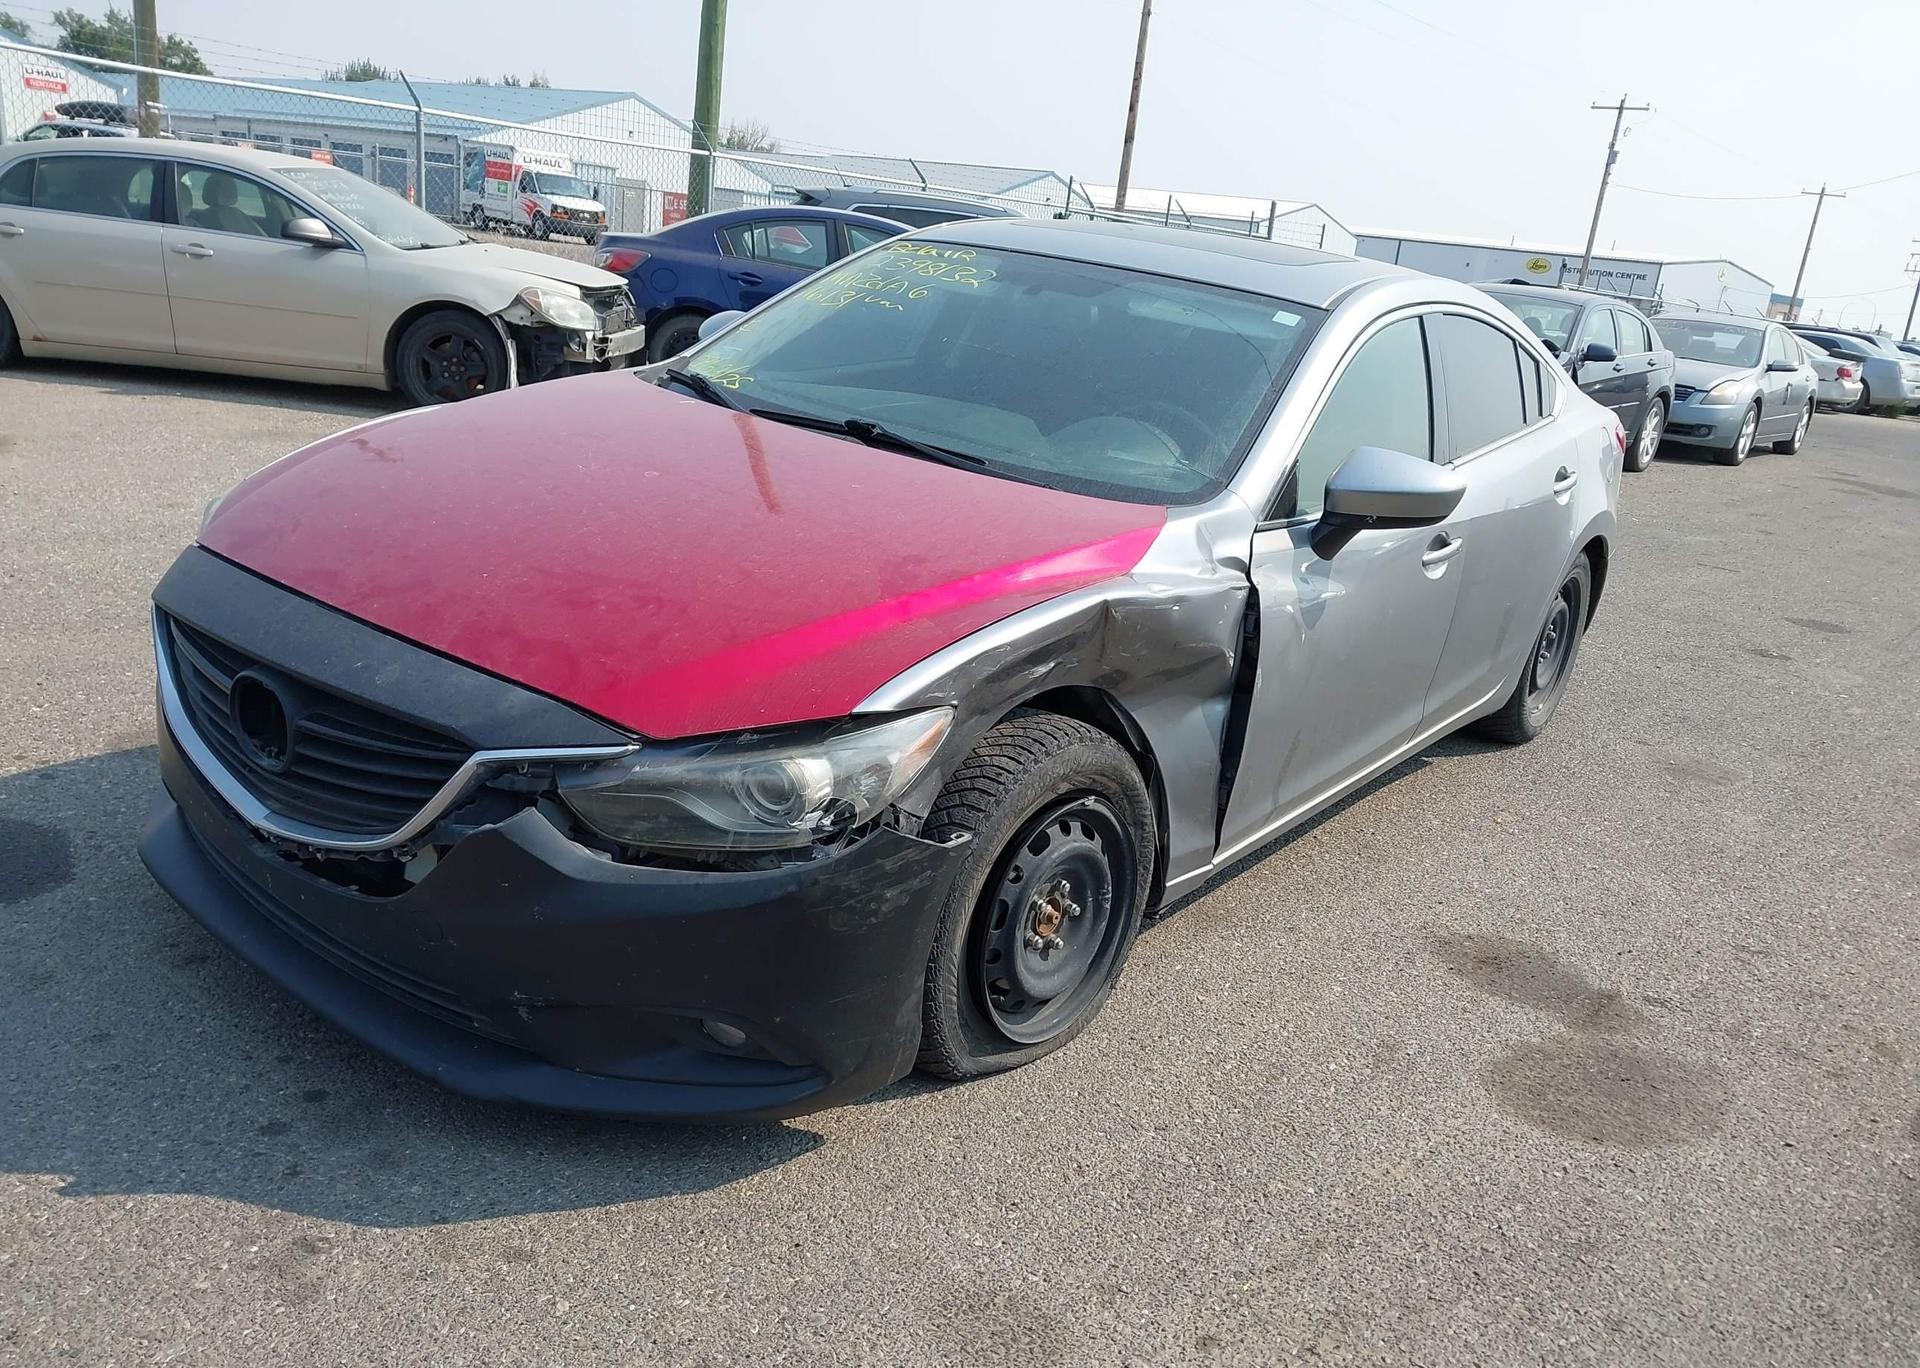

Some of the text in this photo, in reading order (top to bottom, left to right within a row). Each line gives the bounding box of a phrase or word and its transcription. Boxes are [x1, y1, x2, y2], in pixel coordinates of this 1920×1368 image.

[24, 66, 66, 80] U-HAUL
[486, 149, 510, 161] U-HAUL
[523, 155, 564, 169] U-HAUL
[1615, 270, 1648, 281] CENTRE
